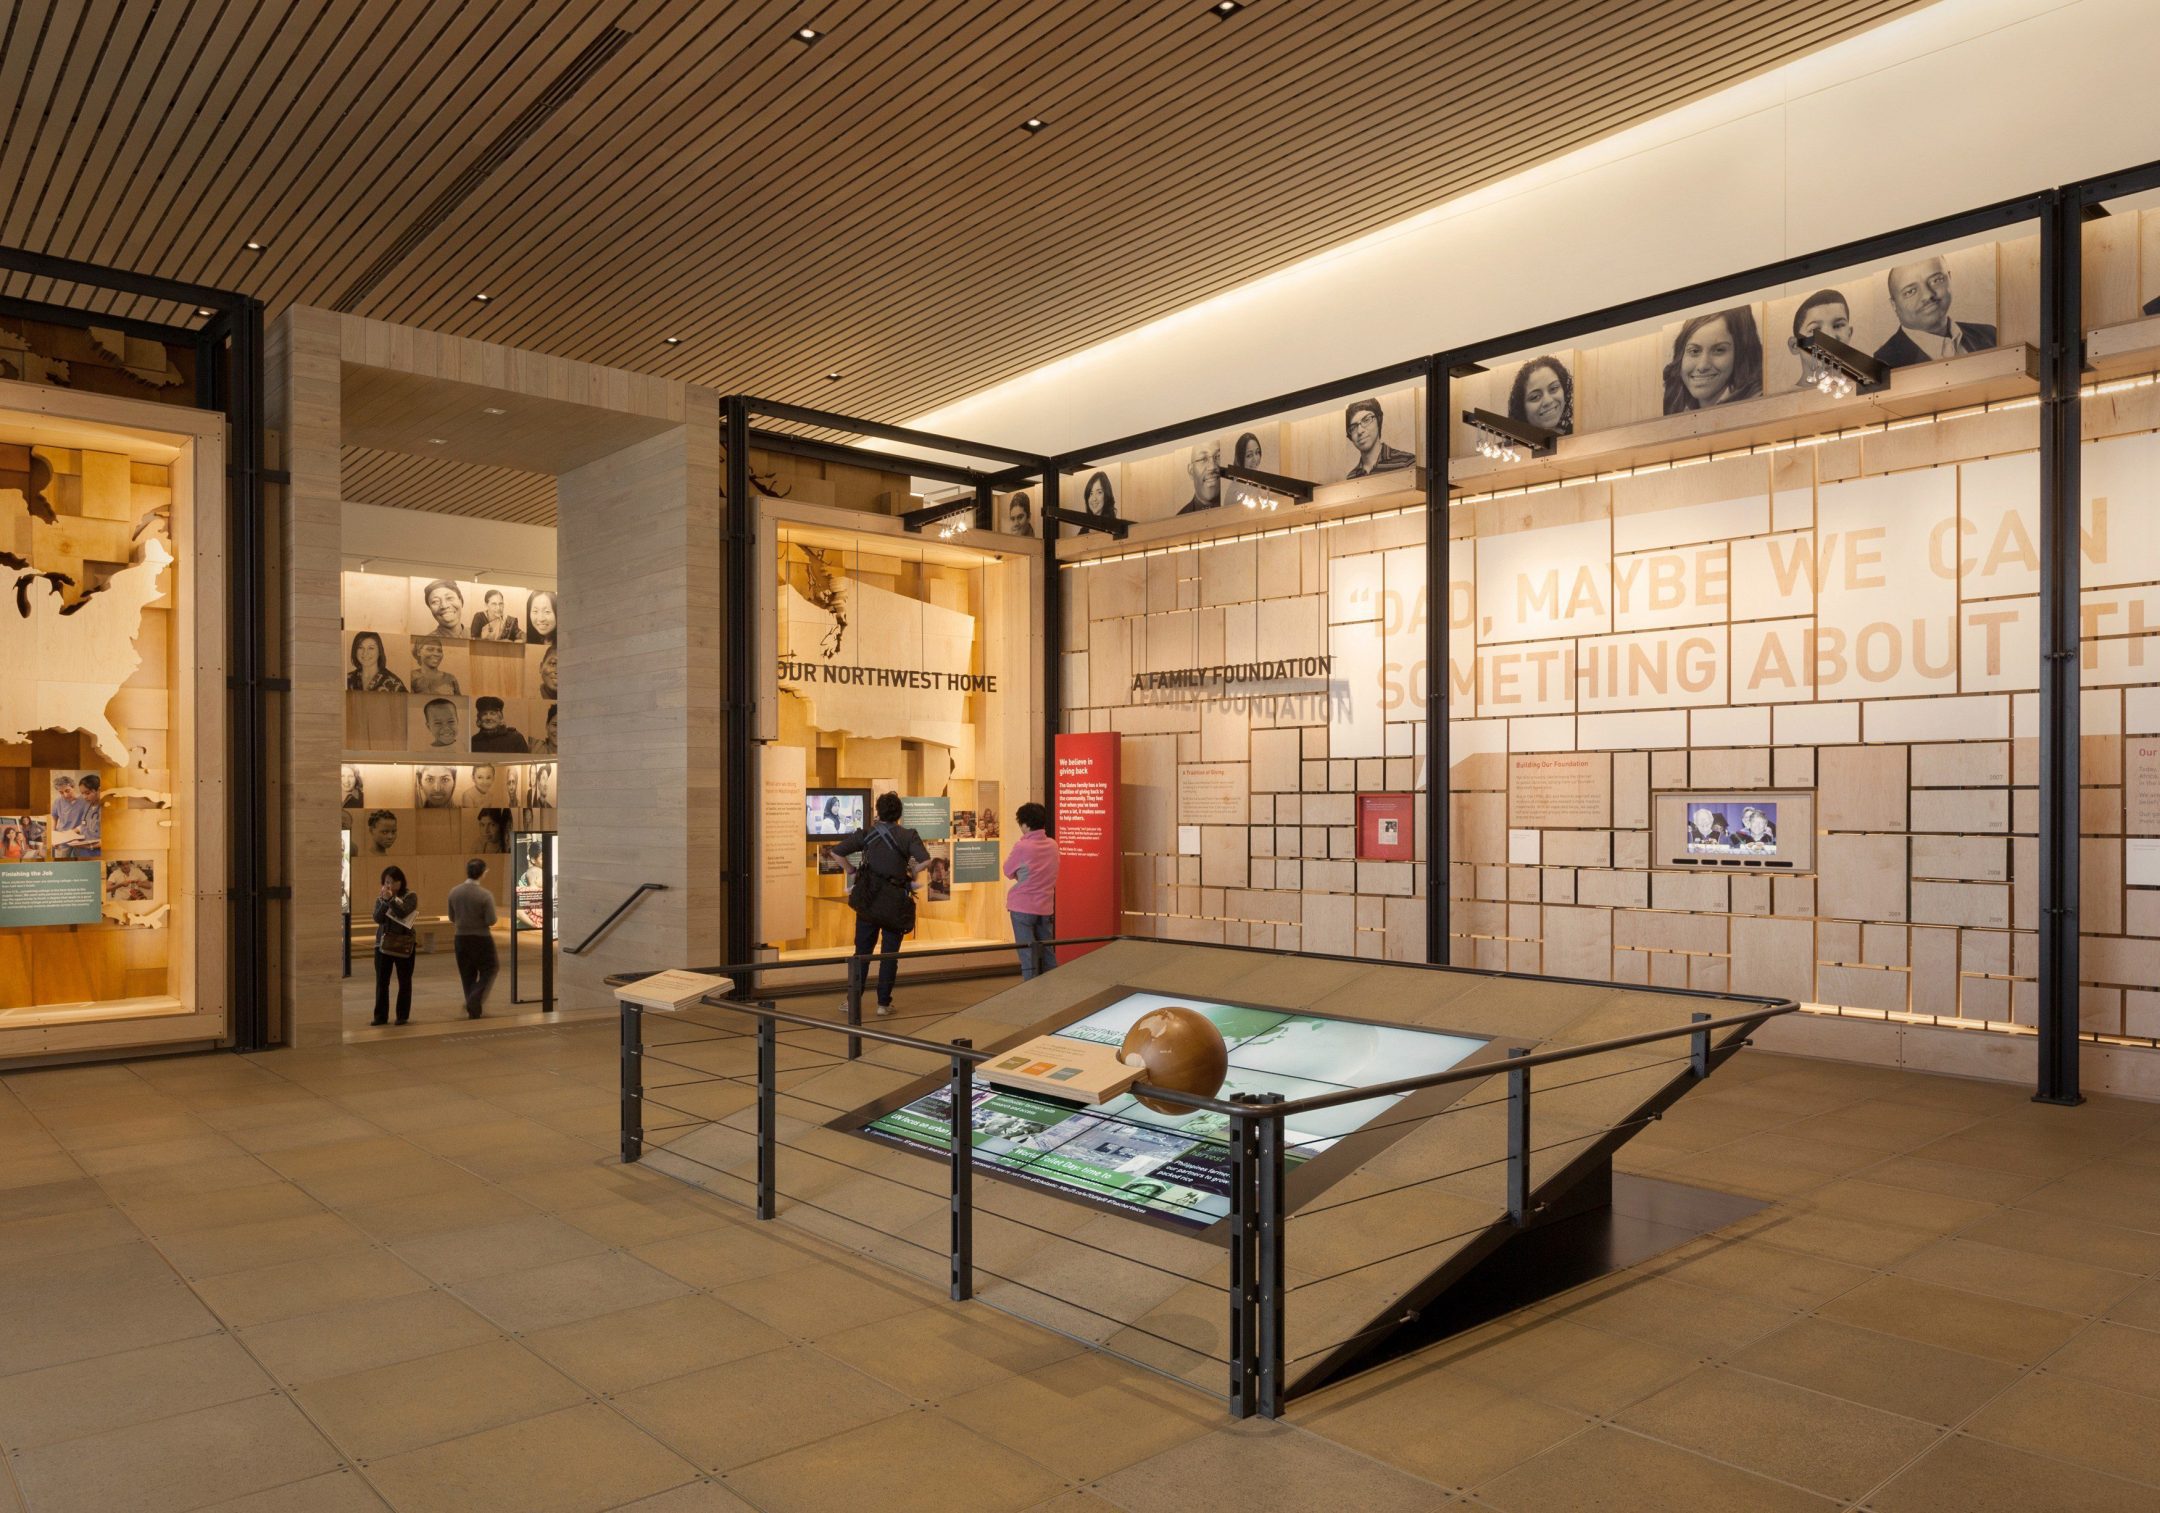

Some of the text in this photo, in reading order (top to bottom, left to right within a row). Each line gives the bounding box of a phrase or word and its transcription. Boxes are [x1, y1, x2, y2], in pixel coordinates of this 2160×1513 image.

[1516, 550, 1729, 624] MAYBE
[1766, 526, 1887, 597] WE
[1376, 637, 1717, 710] SOMETHING
[1747, 610, 2020, 690] ABOUT
[778, 661, 998, 693] OUR NORTHWEST HOME
[1132, 655, 1332, 691] A FAMILY FOUNDATION
[1059, 757, 1093, 766] We believe in
[2139, 748, 2158, 757] Our
[1059, 767, 1074, 776] giving
[1516, 761, 1541, 769] Building
[1553, 760, 1590, 768] Foundation
[890, 1113, 904, 1121] UN
[901, 1115, 920, 1126] focus
[1014, 1148, 1041, 1160] World
[1039, 1154, 1064, 1167] Toilet
[1061, 1160, 1081, 1172] Day:
[1081, 1166, 1103, 1177] time
